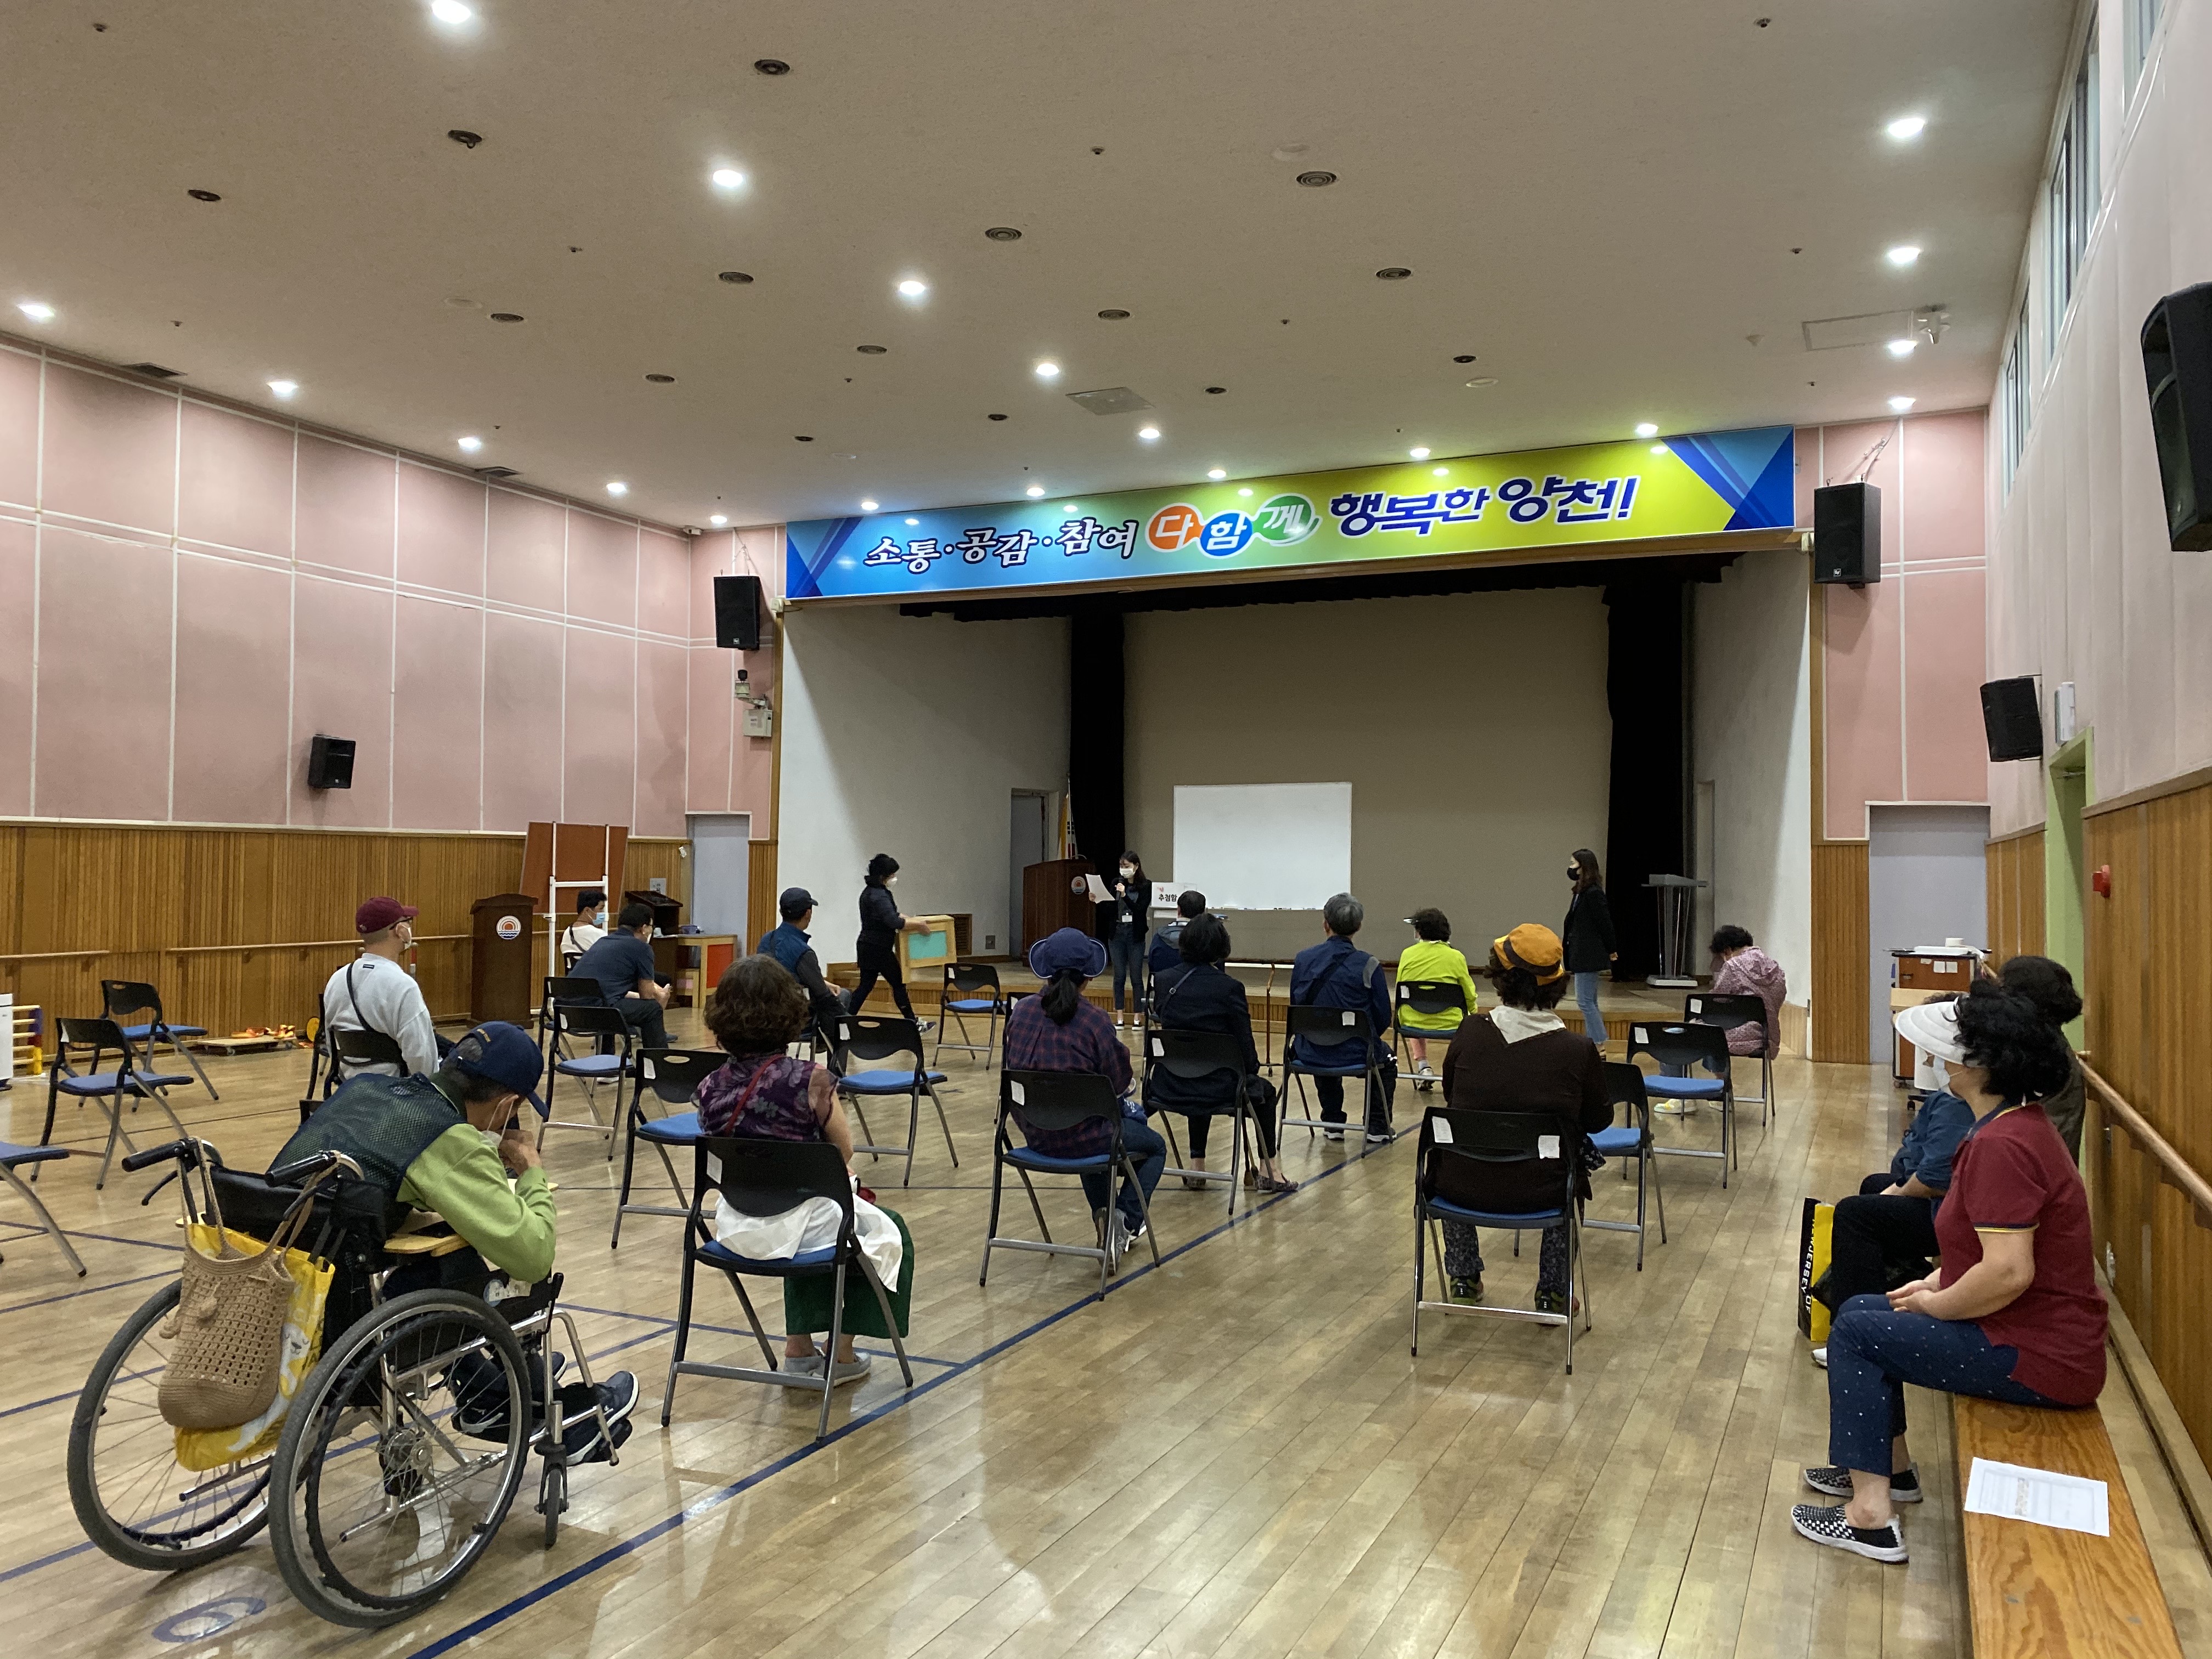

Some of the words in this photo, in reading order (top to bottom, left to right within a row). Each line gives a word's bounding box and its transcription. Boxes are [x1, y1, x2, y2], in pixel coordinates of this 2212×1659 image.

[1154, 502, 1308, 551] 다함께
[1330, 488, 1491, 537] 행복한
[1498, 476, 1639, 523] 양천!
